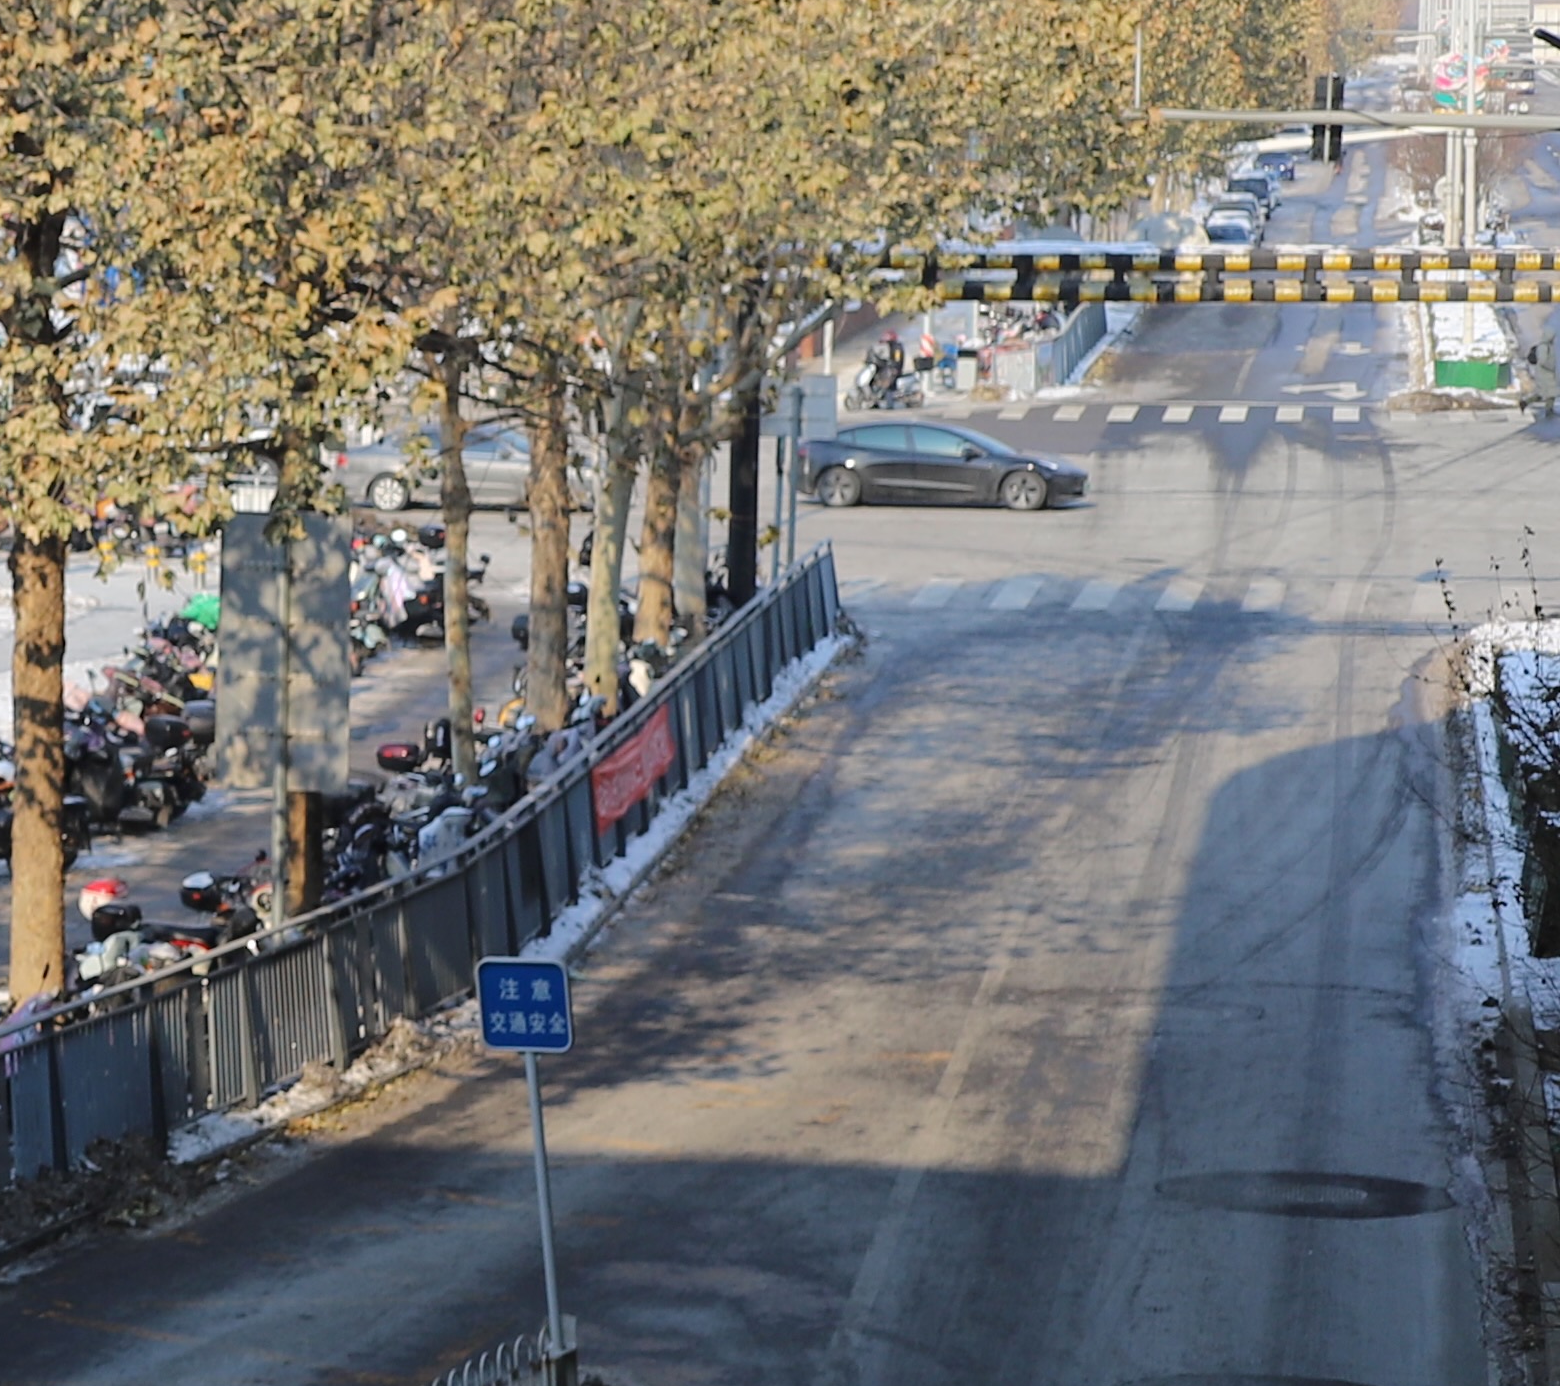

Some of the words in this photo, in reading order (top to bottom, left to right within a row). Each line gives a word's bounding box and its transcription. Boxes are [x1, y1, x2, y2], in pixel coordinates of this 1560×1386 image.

[499, 977, 552, 1002] 注意
[489, 1010, 567, 1035] 交通安全
